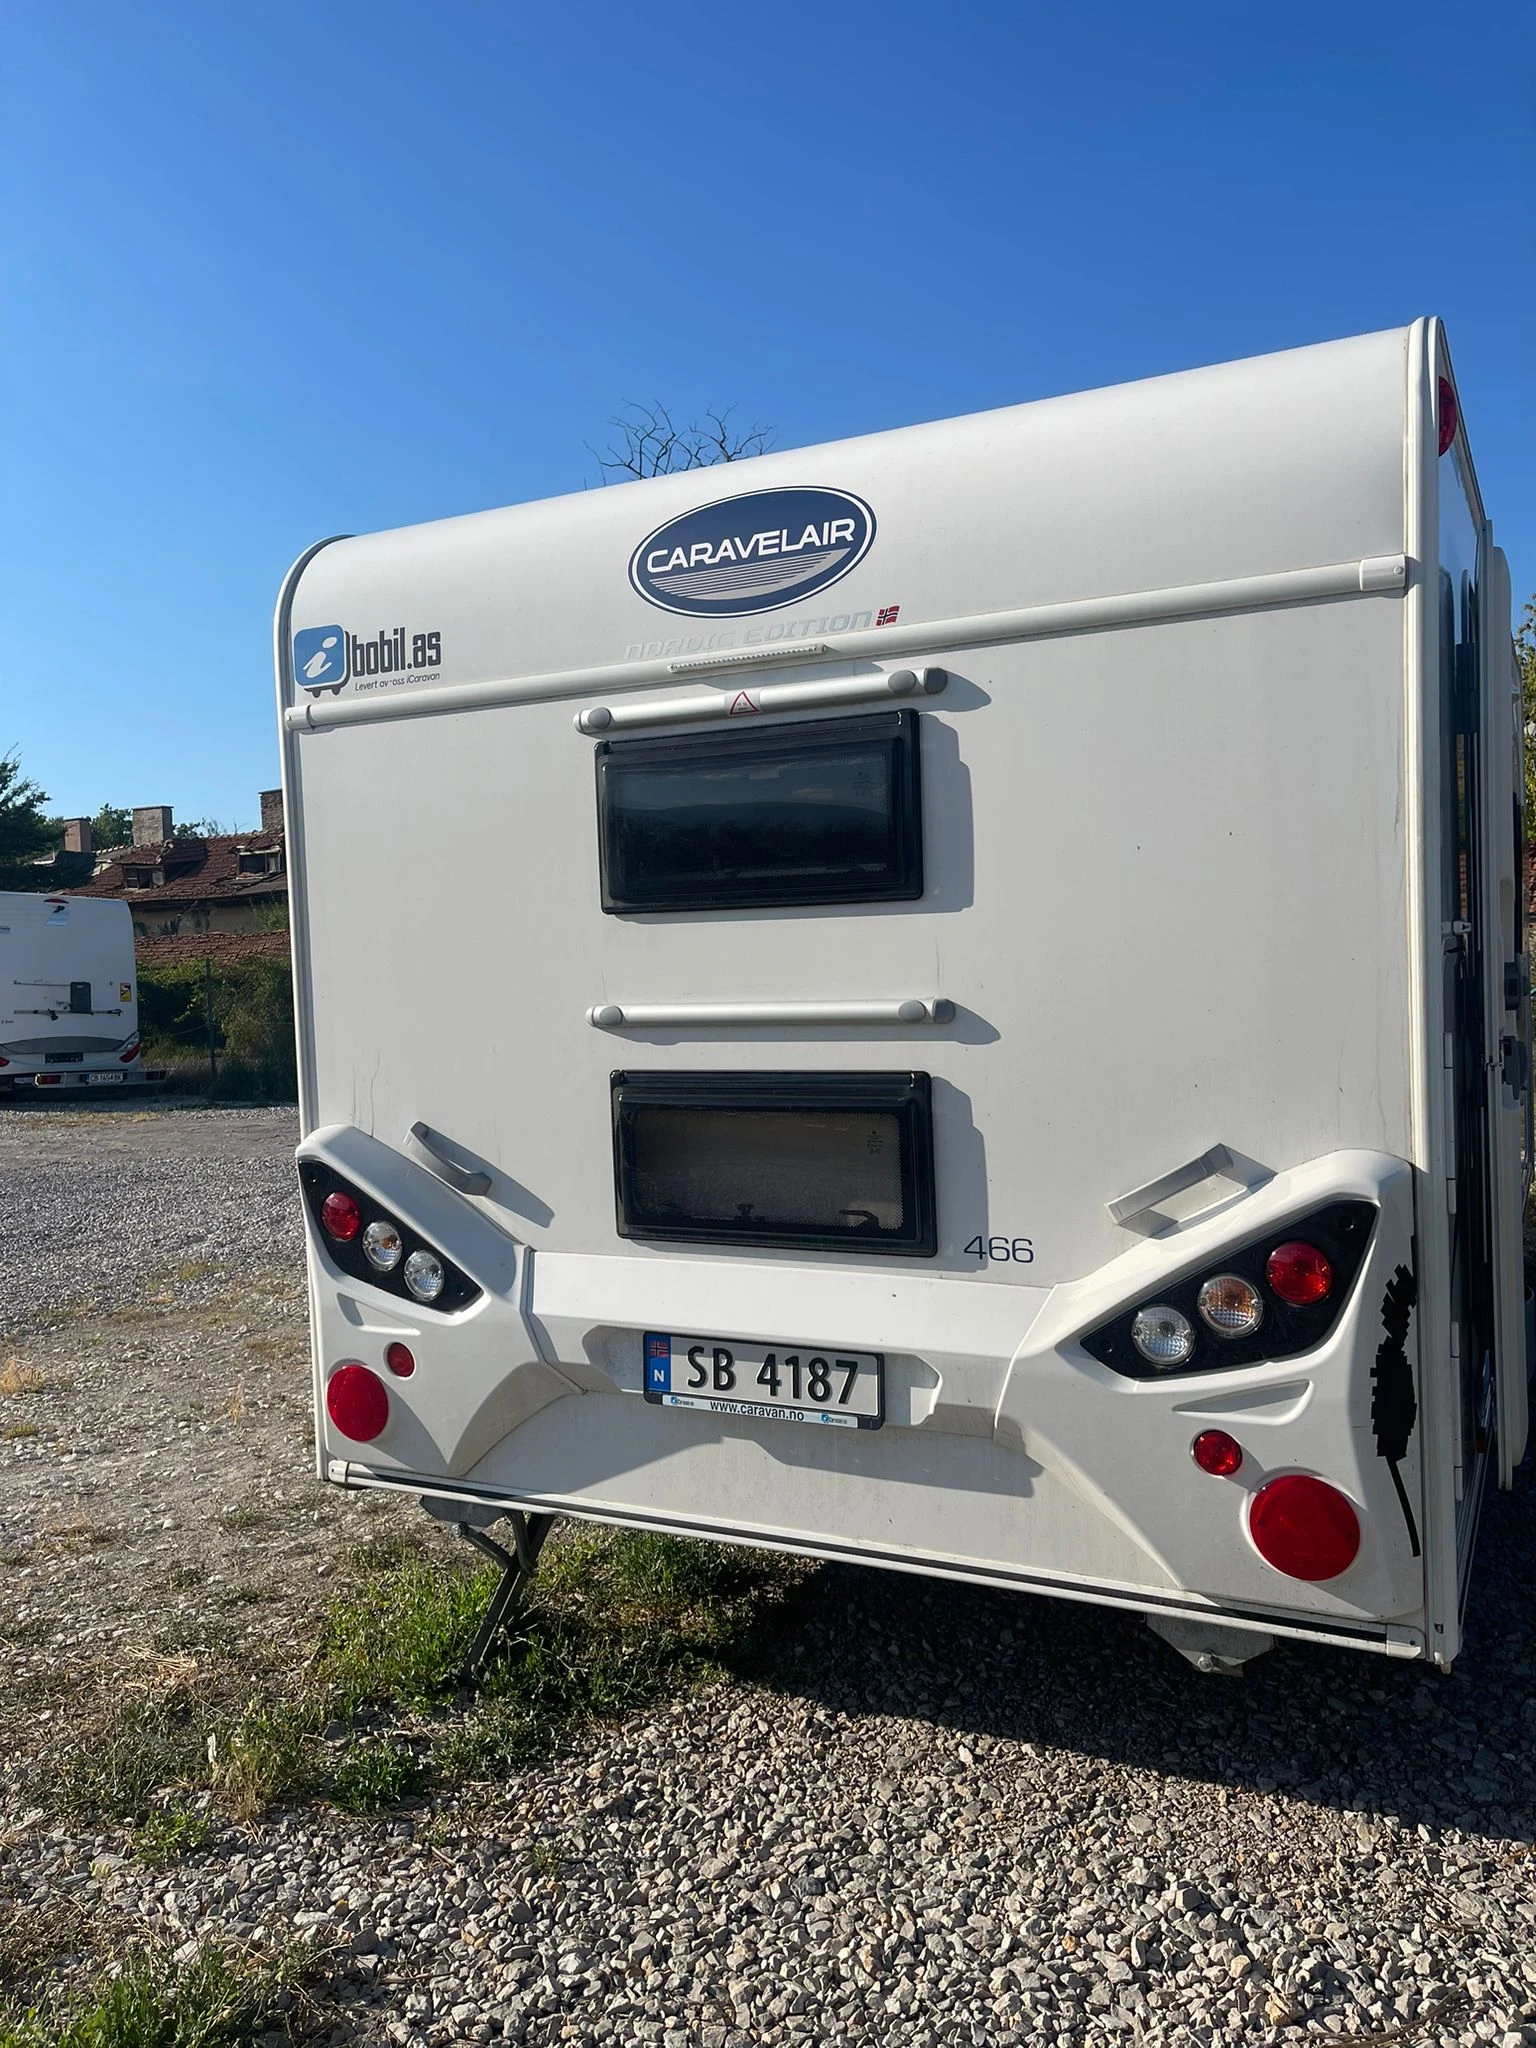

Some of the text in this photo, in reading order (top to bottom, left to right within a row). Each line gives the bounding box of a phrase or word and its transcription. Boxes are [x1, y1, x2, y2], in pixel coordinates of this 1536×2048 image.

[647, 518, 856, 574] CARAVELAIR
[626, 611, 872, 660] NORDIC EDITION
[354, 680, 378, 692] Levert
[406, 672, 441, 685] iCaravan
[963, 1235, 1034, 1264] 466
[653, 1344, 859, 1405] N SB 4187
[709, 1400, 805, 1422] www.caravan.no
